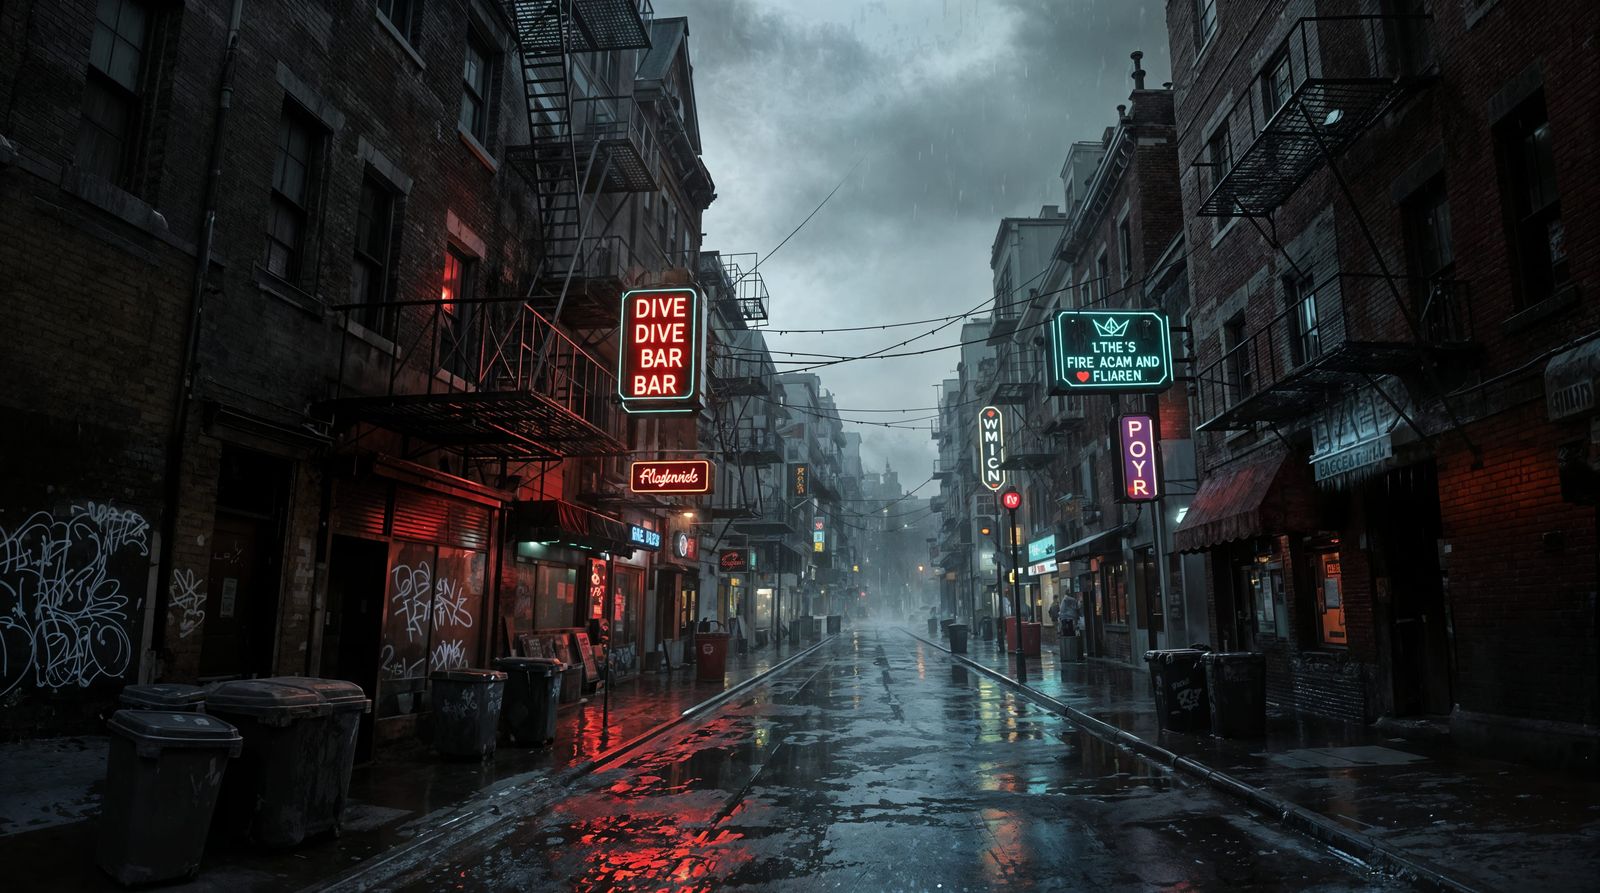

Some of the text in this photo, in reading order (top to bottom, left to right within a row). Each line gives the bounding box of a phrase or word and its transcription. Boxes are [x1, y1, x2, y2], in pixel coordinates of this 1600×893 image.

[636, 297, 686, 318] DIVE
[635, 323, 685, 343] DIVE
[641, 348, 682, 368] BAR
[1067, 355, 1160, 369] FIRE ACAM AND
[634, 374, 677, 395] BAR
[1093, 369, 1142, 382] FLIAREN
[1127, 420, 1149, 496] POYR
